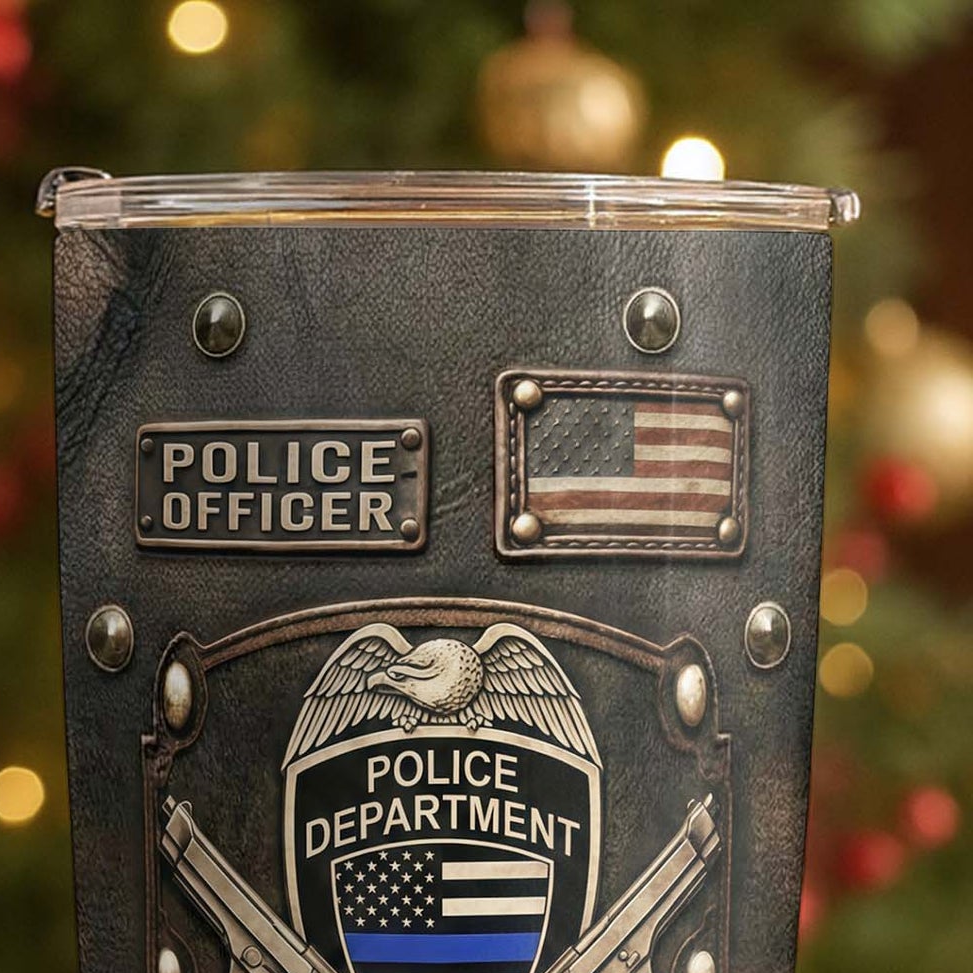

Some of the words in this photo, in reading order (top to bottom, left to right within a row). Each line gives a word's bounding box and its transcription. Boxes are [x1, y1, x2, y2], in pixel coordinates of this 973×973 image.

[163, 440, 396, 484] POLICE
[163, 491, 393, 532] OFFICER
[367, 751, 518, 793] POLICE
[306, 795, 580, 859] DEPARTMENT
